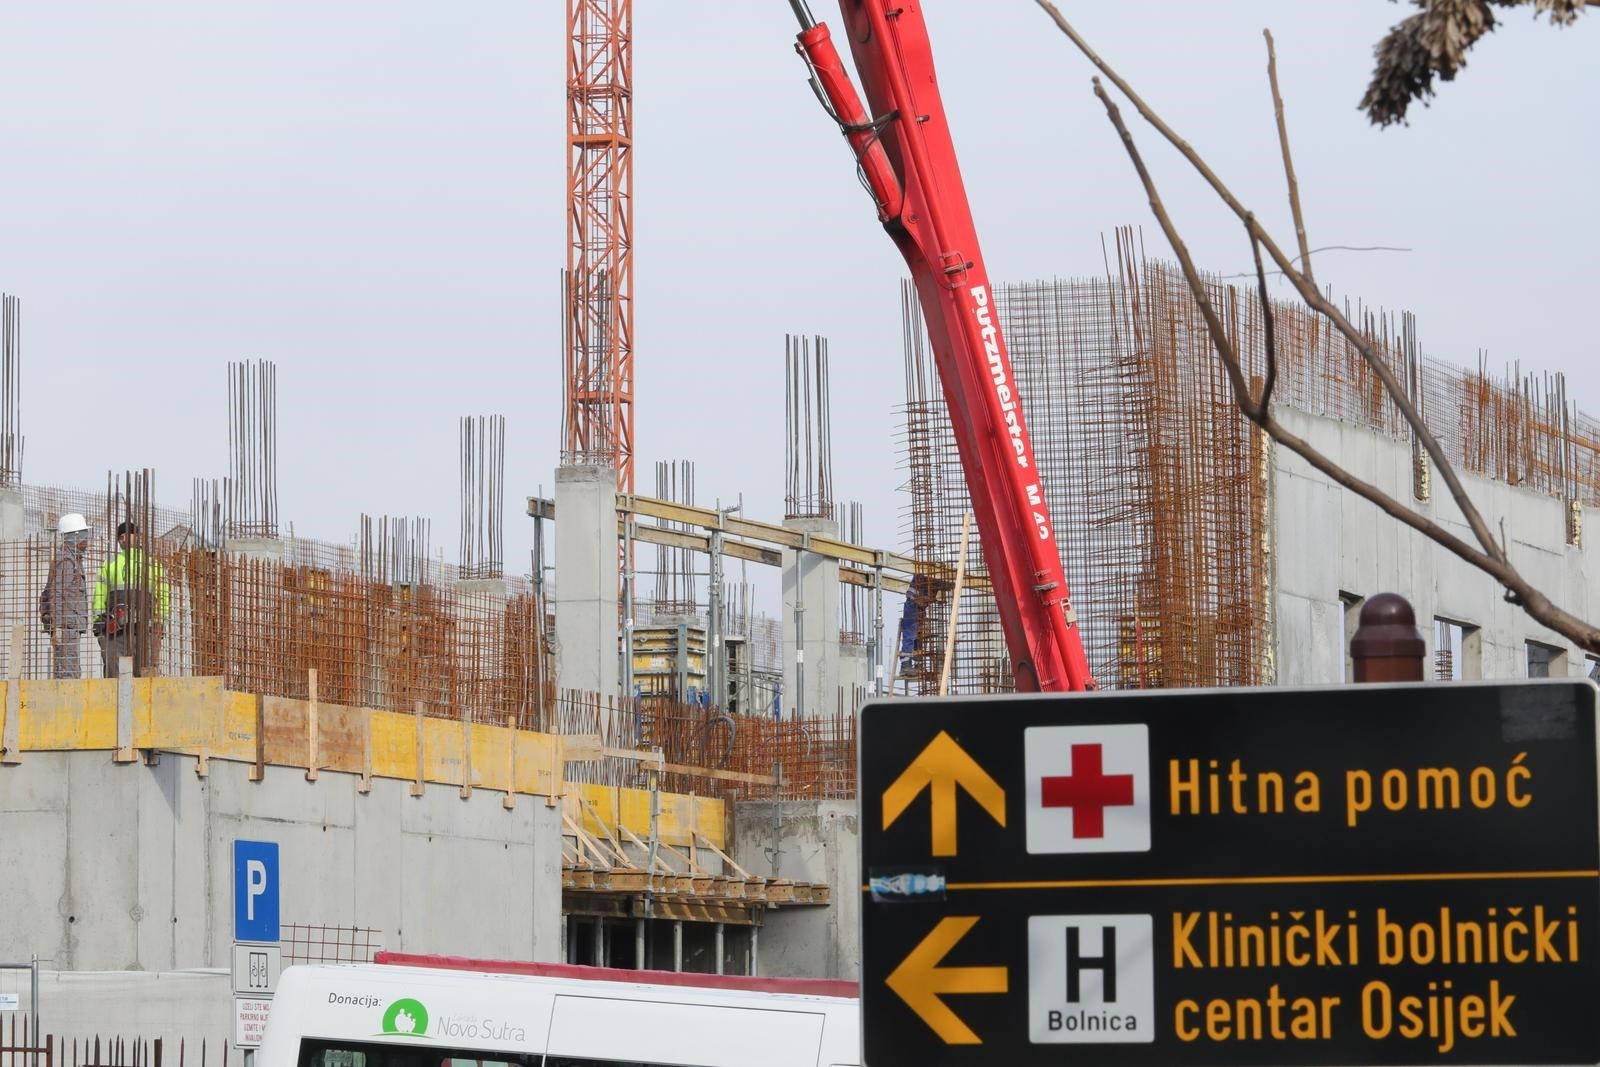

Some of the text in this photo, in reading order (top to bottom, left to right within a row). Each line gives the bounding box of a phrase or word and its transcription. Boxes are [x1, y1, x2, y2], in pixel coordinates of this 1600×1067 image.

[970, 285, 1049, 540] Putzmeister M 42
[1169, 752, 1533, 827] Hitna pomoć
[247, 859, 267, 921] P
[1065, 926, 1117, 1003] H
[1172, 905, 1579, 968] Klinički bolnički
[328, 992, 383, 1009] Donacija:
[437, 1015, 526, 1042] Novo Sutra
[1048, 1010, 1137, 1031] Bolnica
[1174, 980, 1517, 1053] centar Osijek
